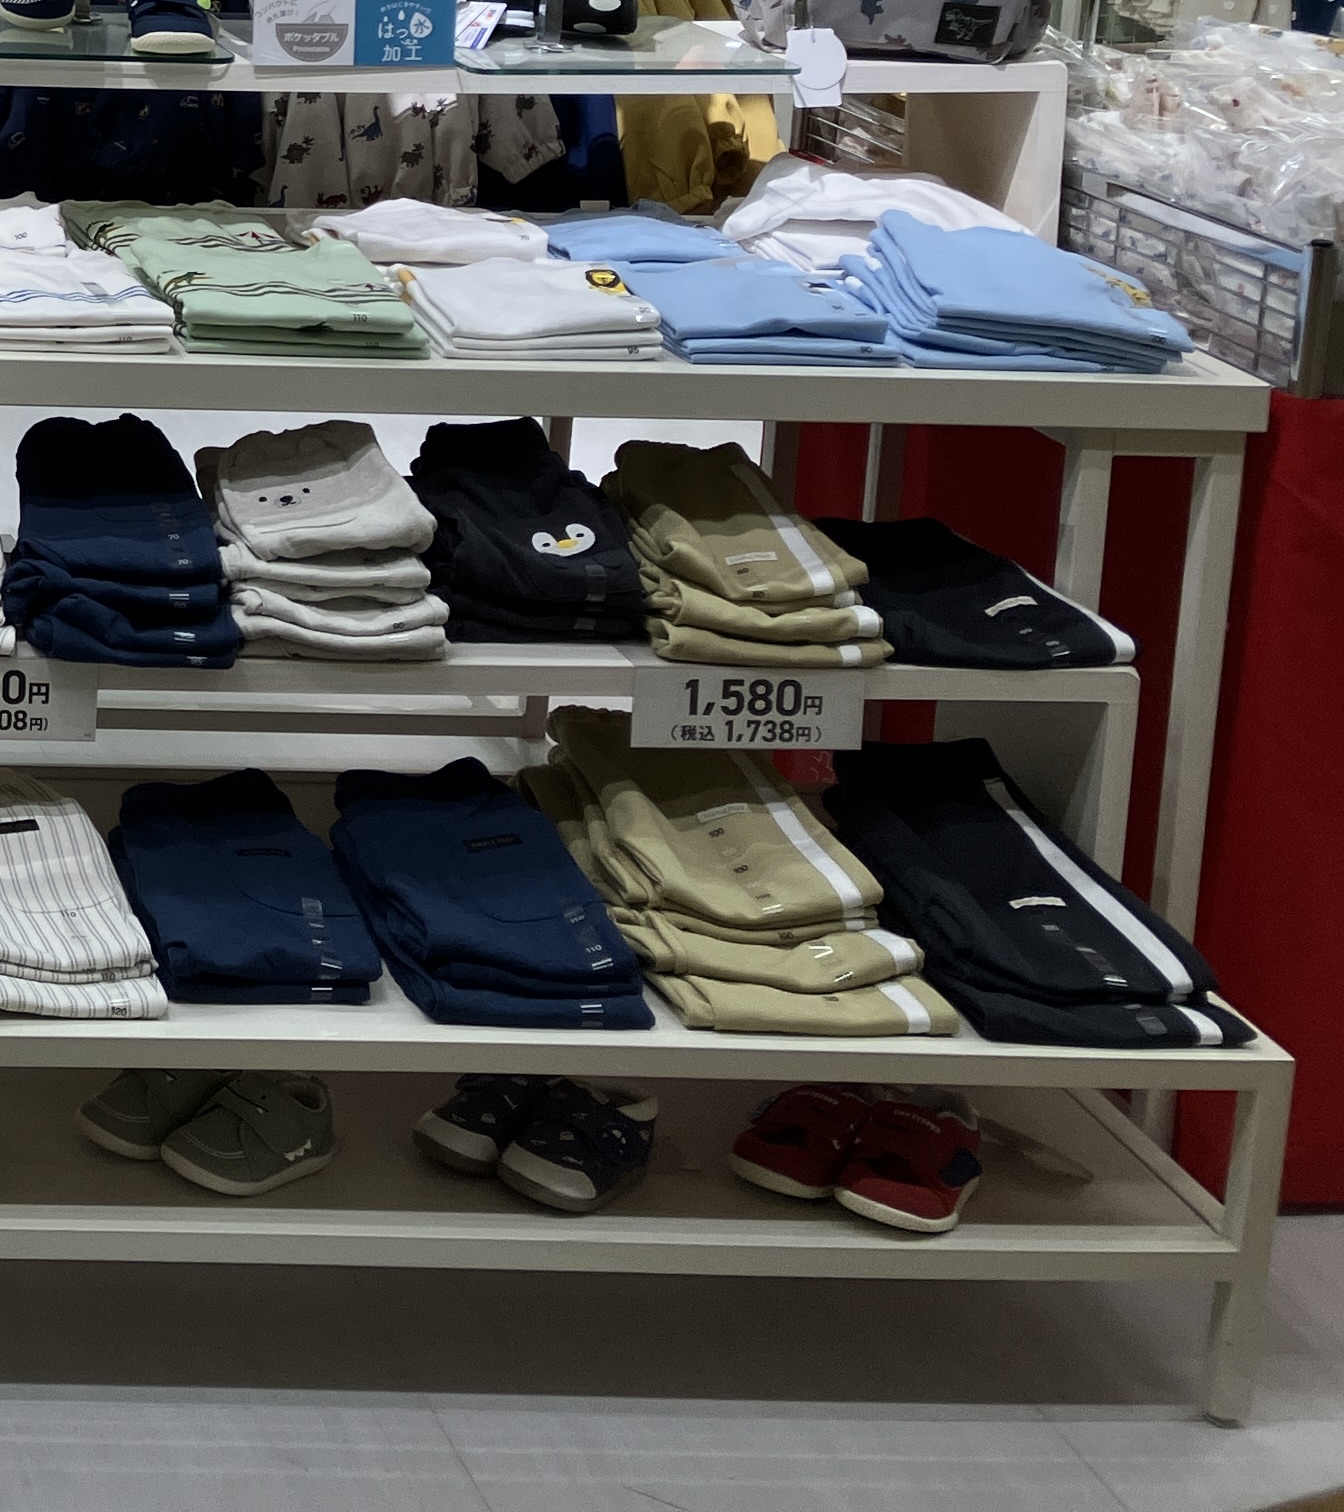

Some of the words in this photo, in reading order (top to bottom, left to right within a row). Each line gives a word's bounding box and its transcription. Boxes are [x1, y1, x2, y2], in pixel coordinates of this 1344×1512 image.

[284, 31, 339, 43] ポケッタブル
[382, 44, 422, 62] 加工
[15, 232, 27, 240] 100
[352, 314, 368, 323] 110
[684, 678, 823, 716] 1,580円
[61, 910, 77, 918] 110
[586, 944, 602, 953] 110
[111, 1006, 128, 1016] 120
